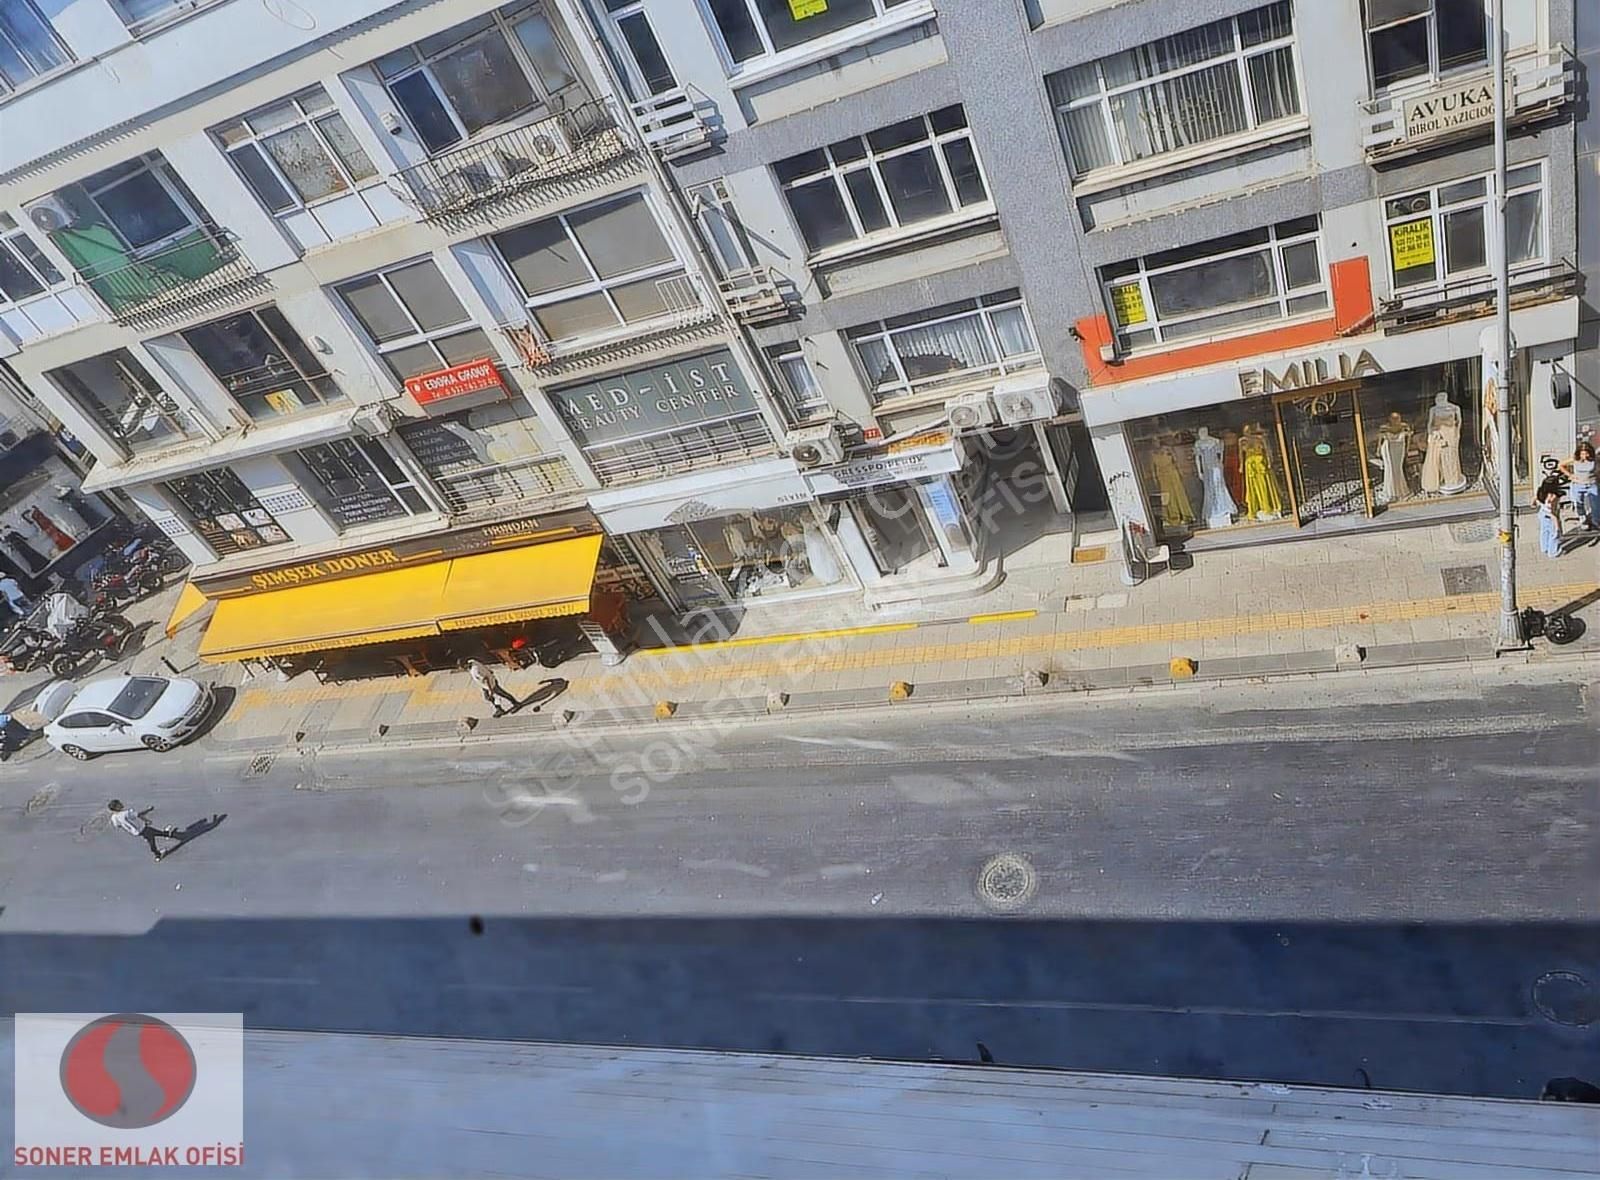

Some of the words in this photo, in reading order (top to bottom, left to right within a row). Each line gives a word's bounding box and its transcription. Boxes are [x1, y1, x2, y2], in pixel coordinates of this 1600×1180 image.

[1411, 83, 1496, 121] AVUKA
[1409, 119, 1441, 136] BİROL
[457, 365, 490, 381] GROUP
[1238, 349, 1384, 397] EMILIA
[571, 405, 641, 433] BEAUTY
[656, 384, 739, 413] CENTER
[252, 563, 327, 590] ŞİMŞEK
